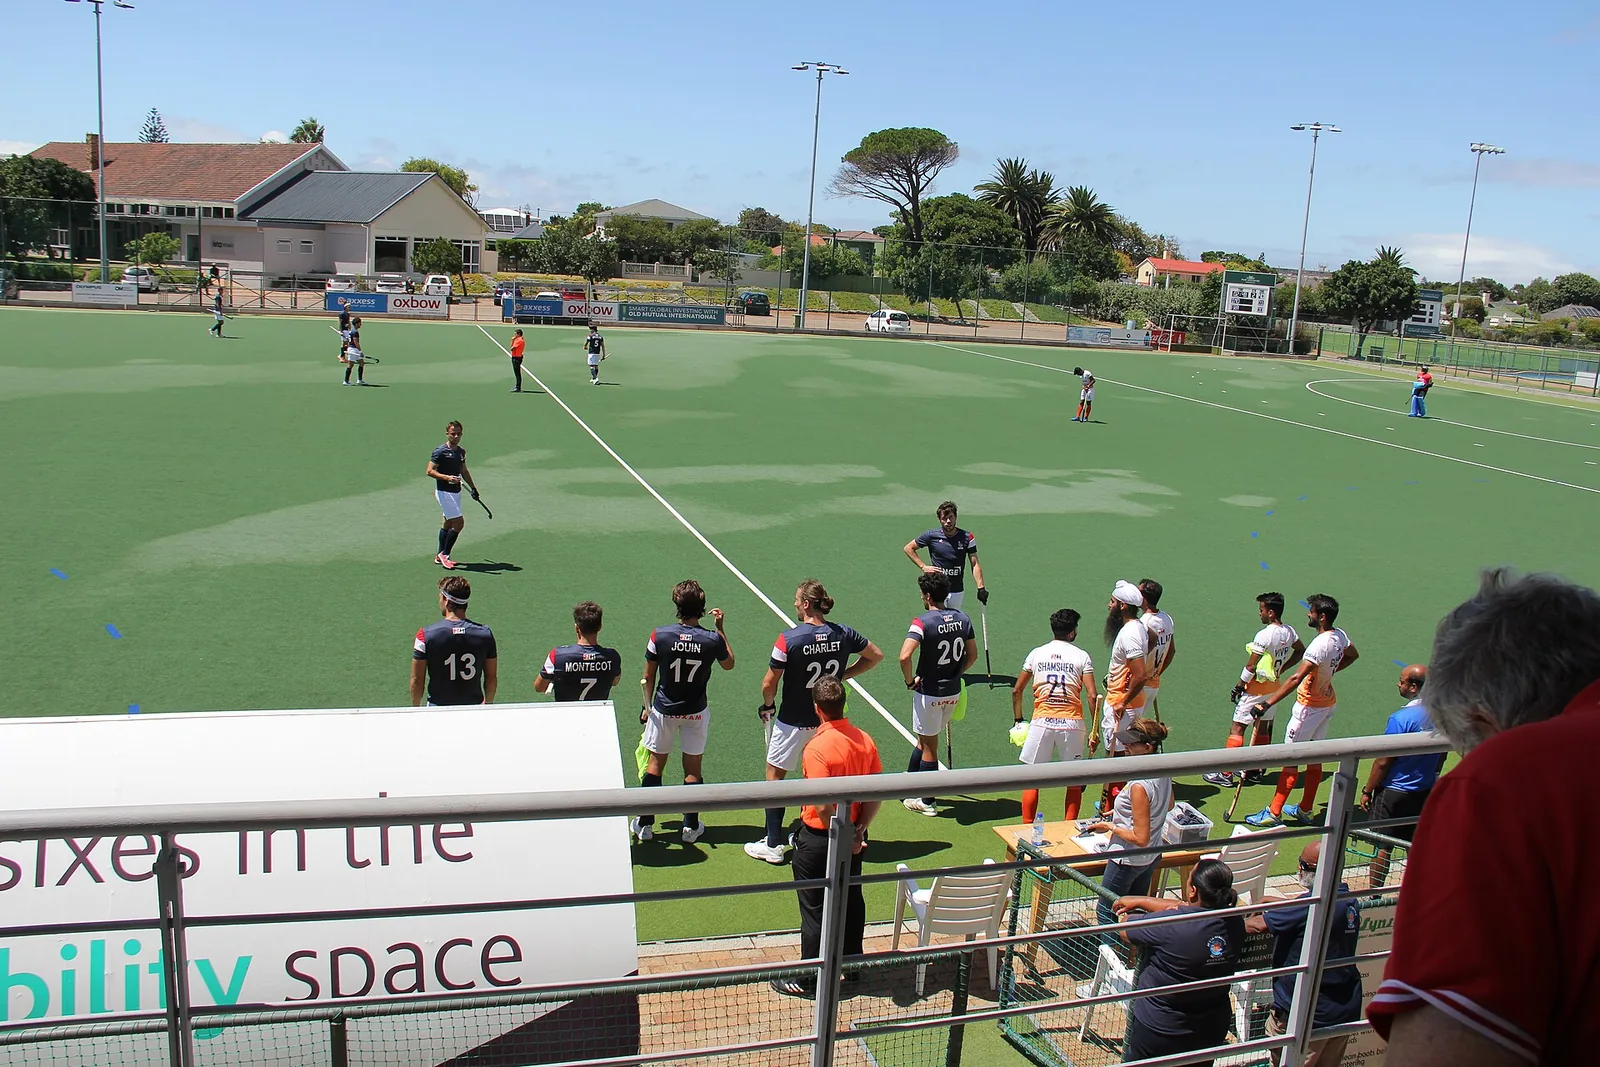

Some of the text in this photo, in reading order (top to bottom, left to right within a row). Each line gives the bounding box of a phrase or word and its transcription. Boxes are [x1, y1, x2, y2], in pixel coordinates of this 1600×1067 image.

[393, 296, 441, 310] oxbow
[523, 304, 552, 312] axxess
[568, 303, 614, 316] oxbow
[943, 568, 959, 576] NGE
[938, 621, 963, 634] CURTY
[671, 642, 702, 653] JOUIN
[802, 641, 841, 655] CHARLET
[937, 637, 965, 665] 20
[444, 653, 476, 681] 13
[565, 660, 612, 672] MONTECOT
[670, 658, 702, 683] 17
[1037, 662, 1075, 673] SHAMSHER
[579, 678, 598, 700] 7
[238, 829, 306, 875] in
[346, 792, 474, 869] the
[1248, 944, 1267, 952] ASTRO
[1236, 953, 1274, 964] ANGEMENTS
[0, 934, 523, 1040] bility space
